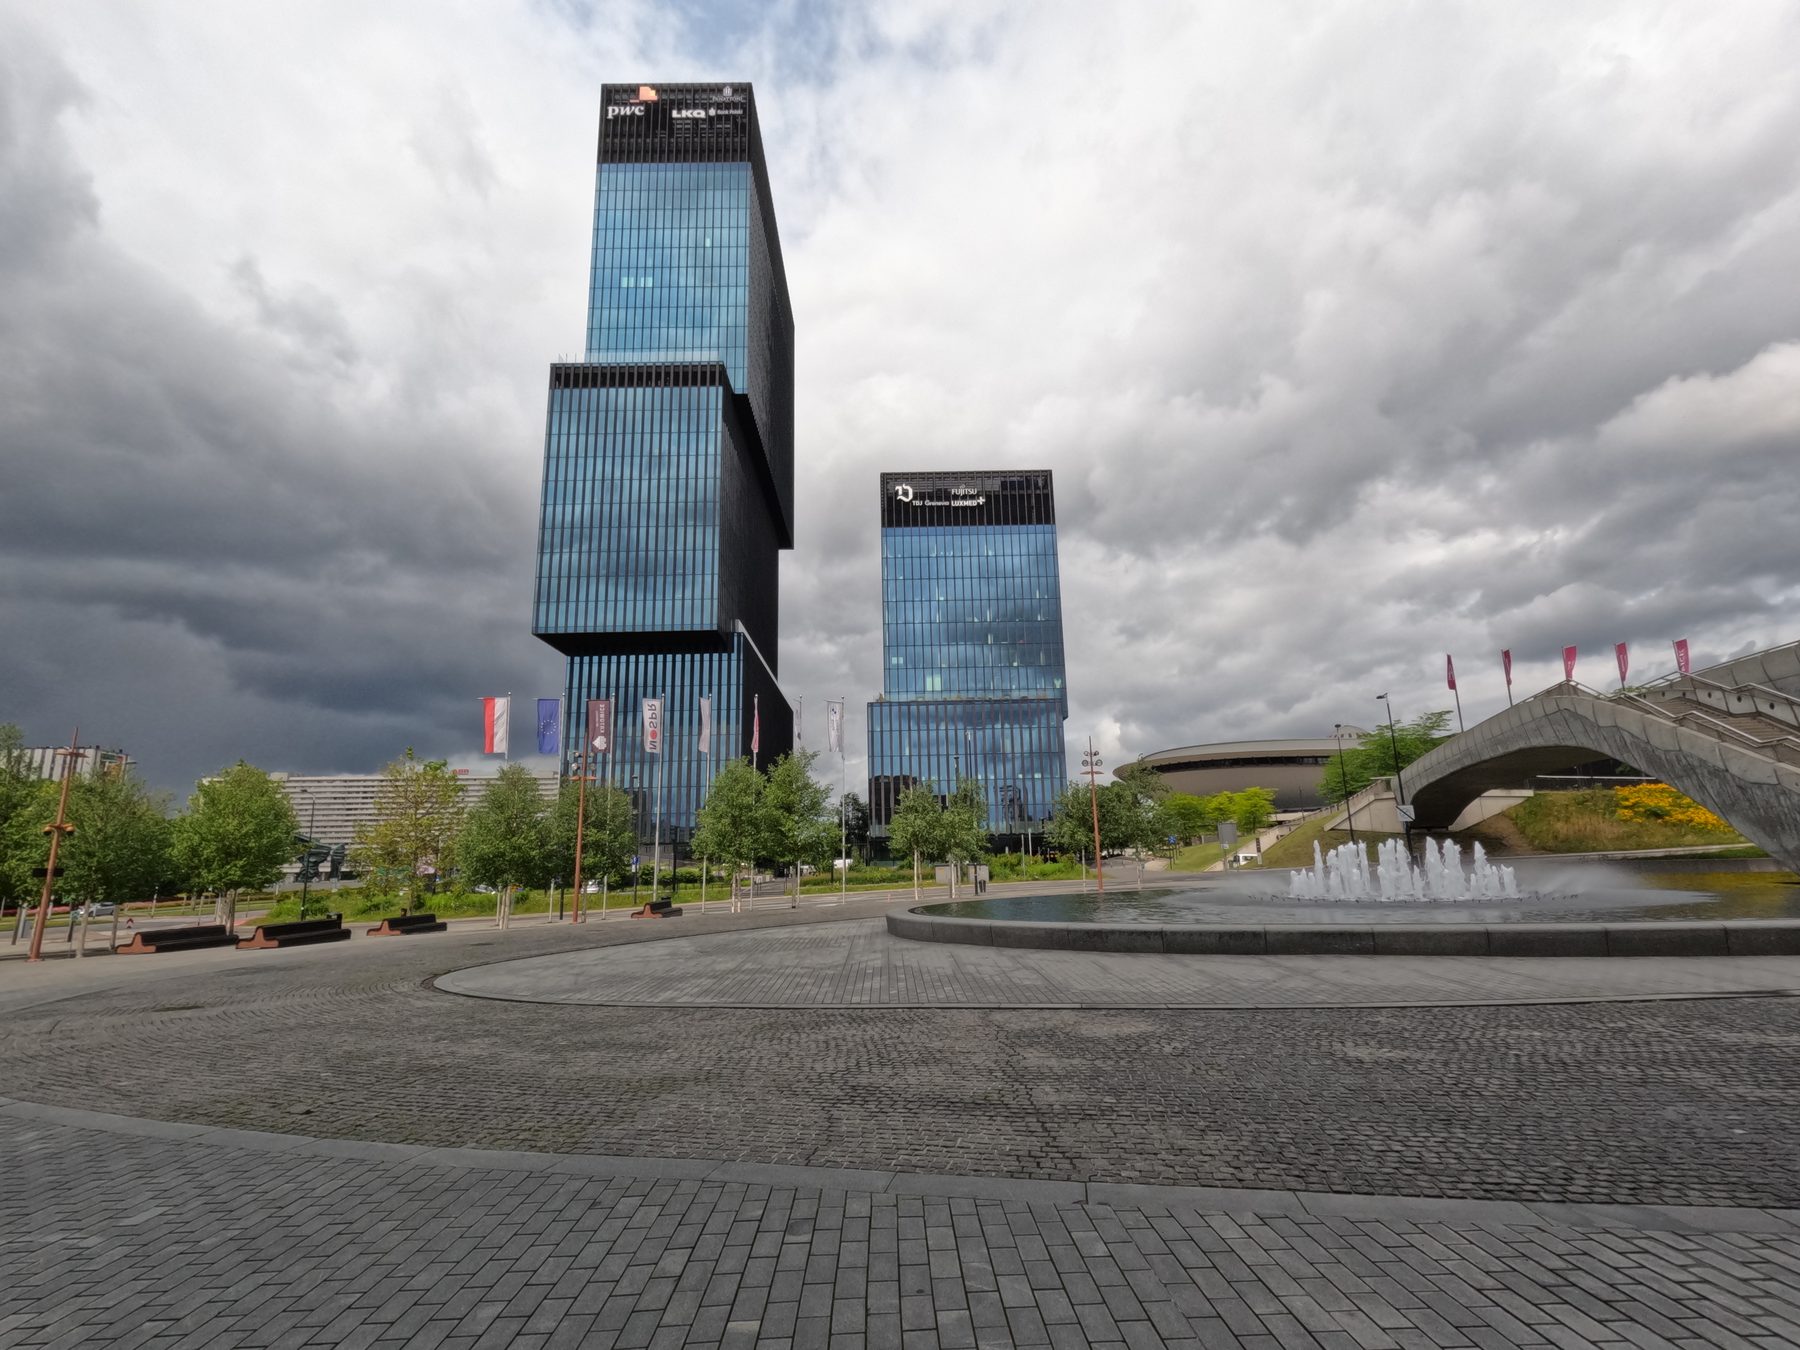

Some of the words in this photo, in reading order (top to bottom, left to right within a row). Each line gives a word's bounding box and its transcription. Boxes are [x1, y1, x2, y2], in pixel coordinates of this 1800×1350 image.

[606, 105, 644, 119] pwc
[671, 109, 706, 118] LKQ
[951, 488, 977, 496] FUJITSU
